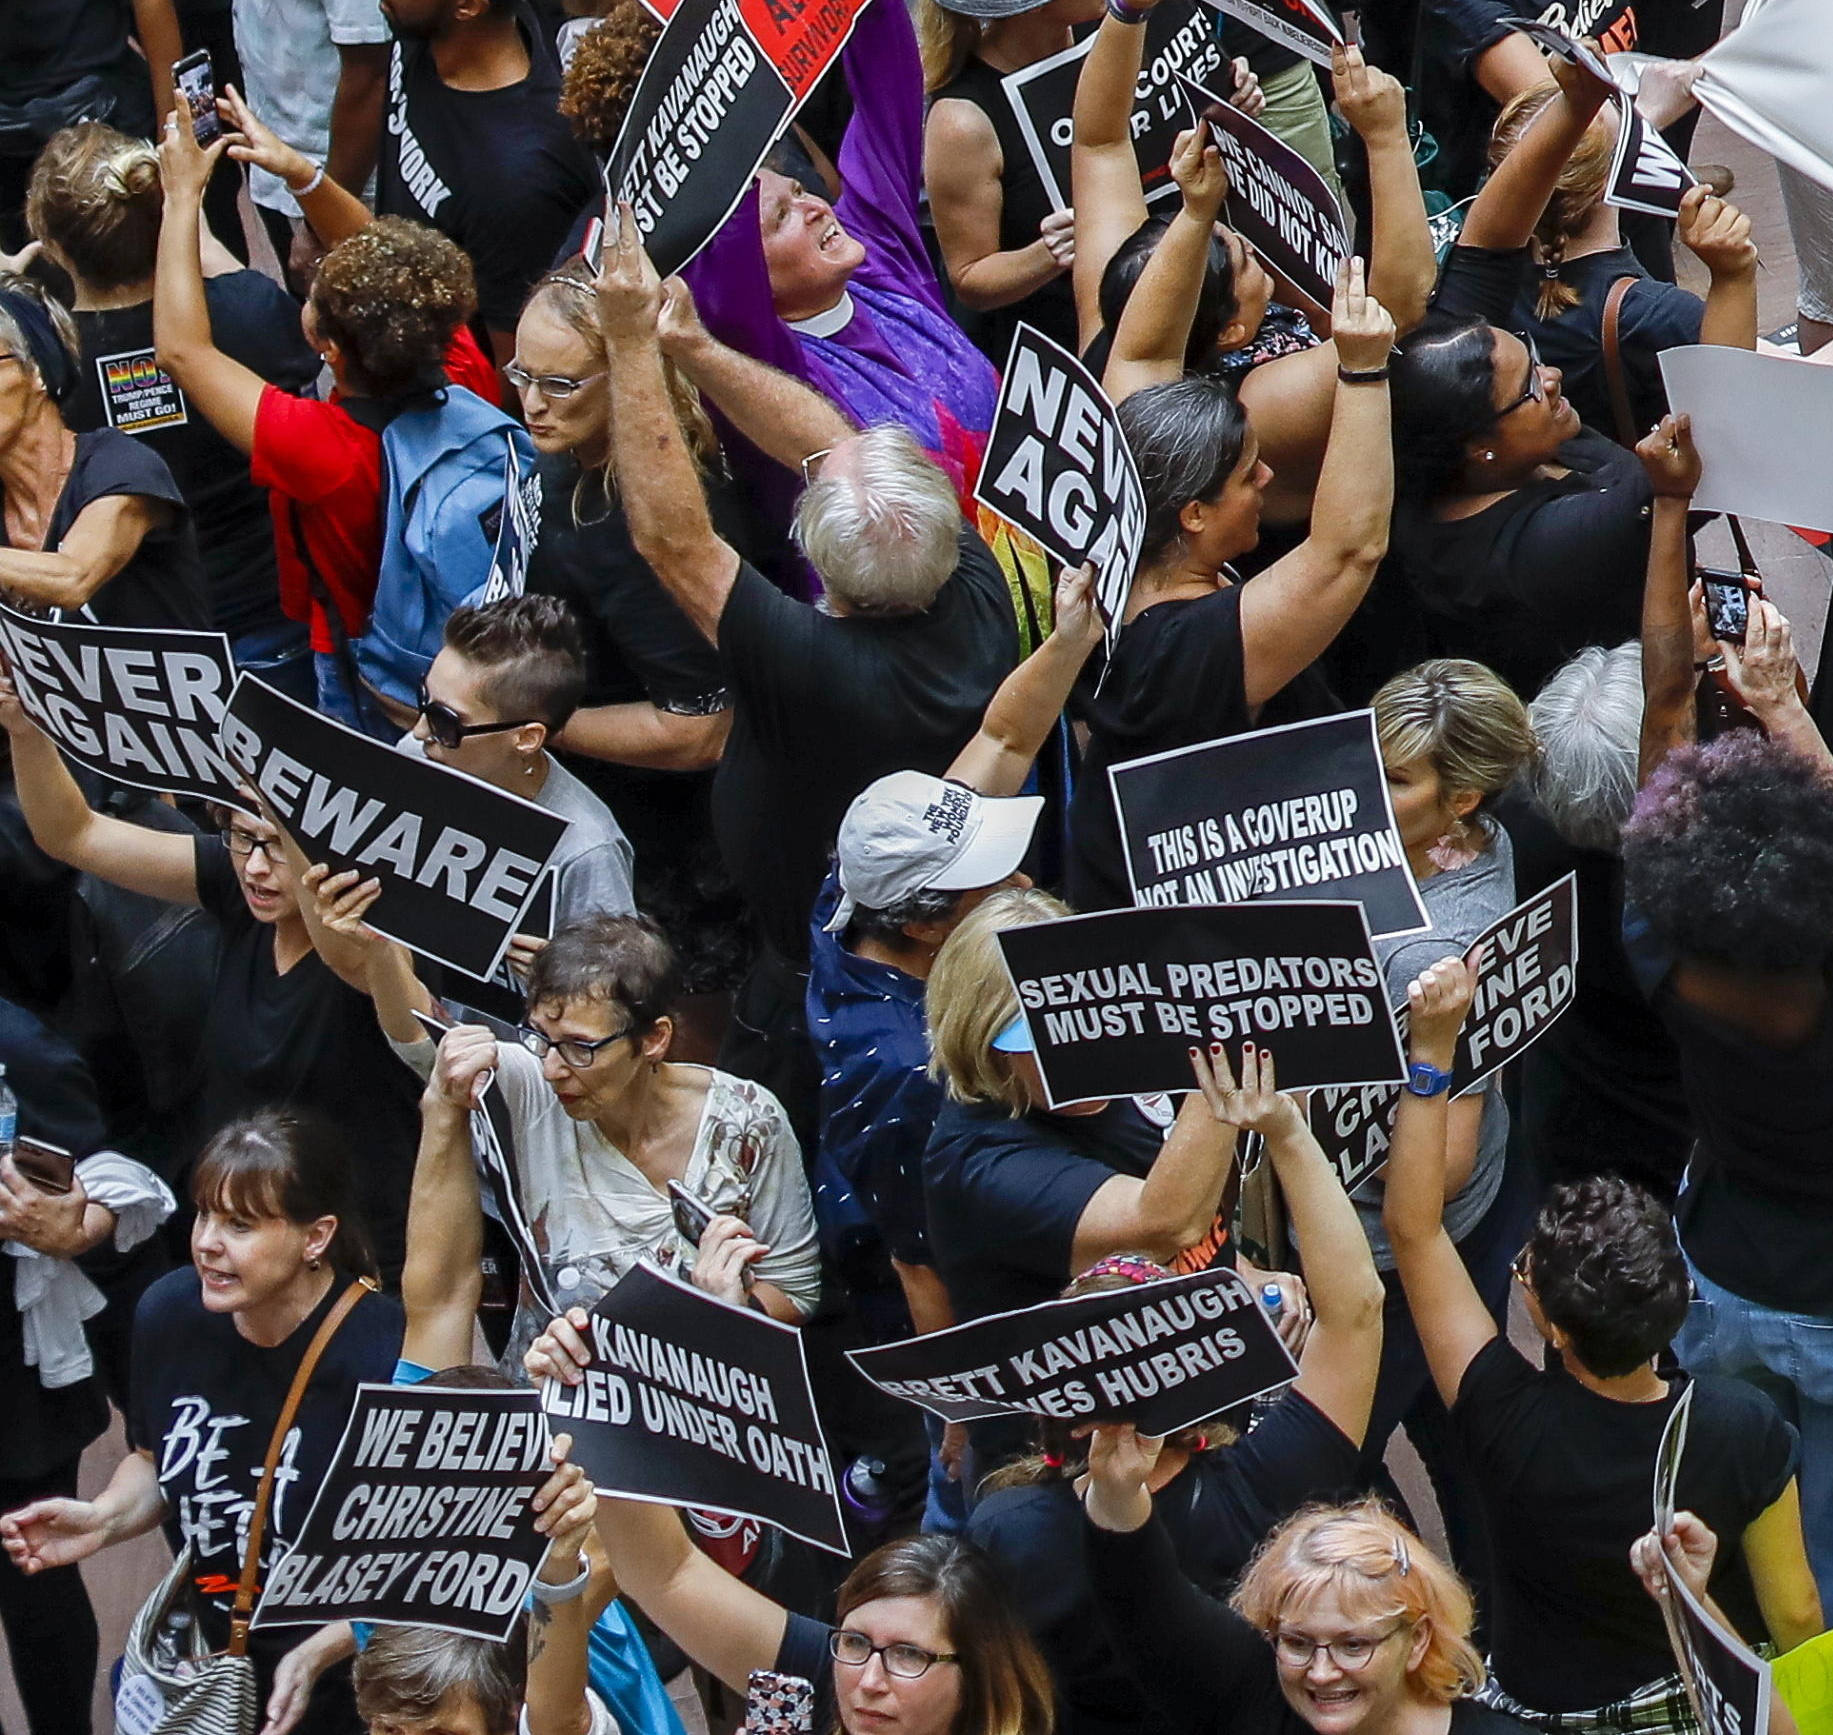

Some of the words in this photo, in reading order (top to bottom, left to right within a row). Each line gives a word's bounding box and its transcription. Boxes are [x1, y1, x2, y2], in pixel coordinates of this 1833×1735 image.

[656, 153, 690, 201] BE
[683, 40, 757, 167] STOPPED
[1214, 123, 1241, 164] WE
[1240, 145, 1316, 226] CANNOT
[1248, 181, 1279, 229] DID
[1277, 203, 1316, 265] NOT
[117, 408, 153, 423] MUST
[223, 712, 542, 922] BEWARE
[1148, 822, 1196, 874] THIS
[1199, 817, 1218, 860] IS
[1226, 816, 1244, 850] A
[1244, 789, 1358, 844] COVERUP
[1184, 869, 1216, 904] AN
[1221, 828, 1401, 903] INVESTIGATION
[1021, 961, 1162, 1011] SEXUAL
[1169, 954, 1378, 1000] PREDATORS
[1045, 999, 1149, 1045] MUST
[1160, 997, 1201, 1038] BE
[1209, 992, 1373, 1042] STOPPED
[1466, 960, 1573, 1071] FORD
[591, 1316, 777, 1425] KAVANAUGH
[1010, 1275, 1255, 1382] KAVANAUGH
[1101, 1326, 1247, 1406] HUBRIS
[159, 1397, 251, 1492] BE
[359, 1406, 420, 1466] WE
[428, 1410, 554, 1472] BELIEV
[545, 1367, 631, 1426] LIED
[640, 1397, 741, 1466] UNDER
[752, 1429, 834, 1496] OATH
[333, 1484, 530, 1541] CHRISTINE
[267, 1549, 410, 1608] BLASEY
[408, 1555, 532, 1616] FORD
